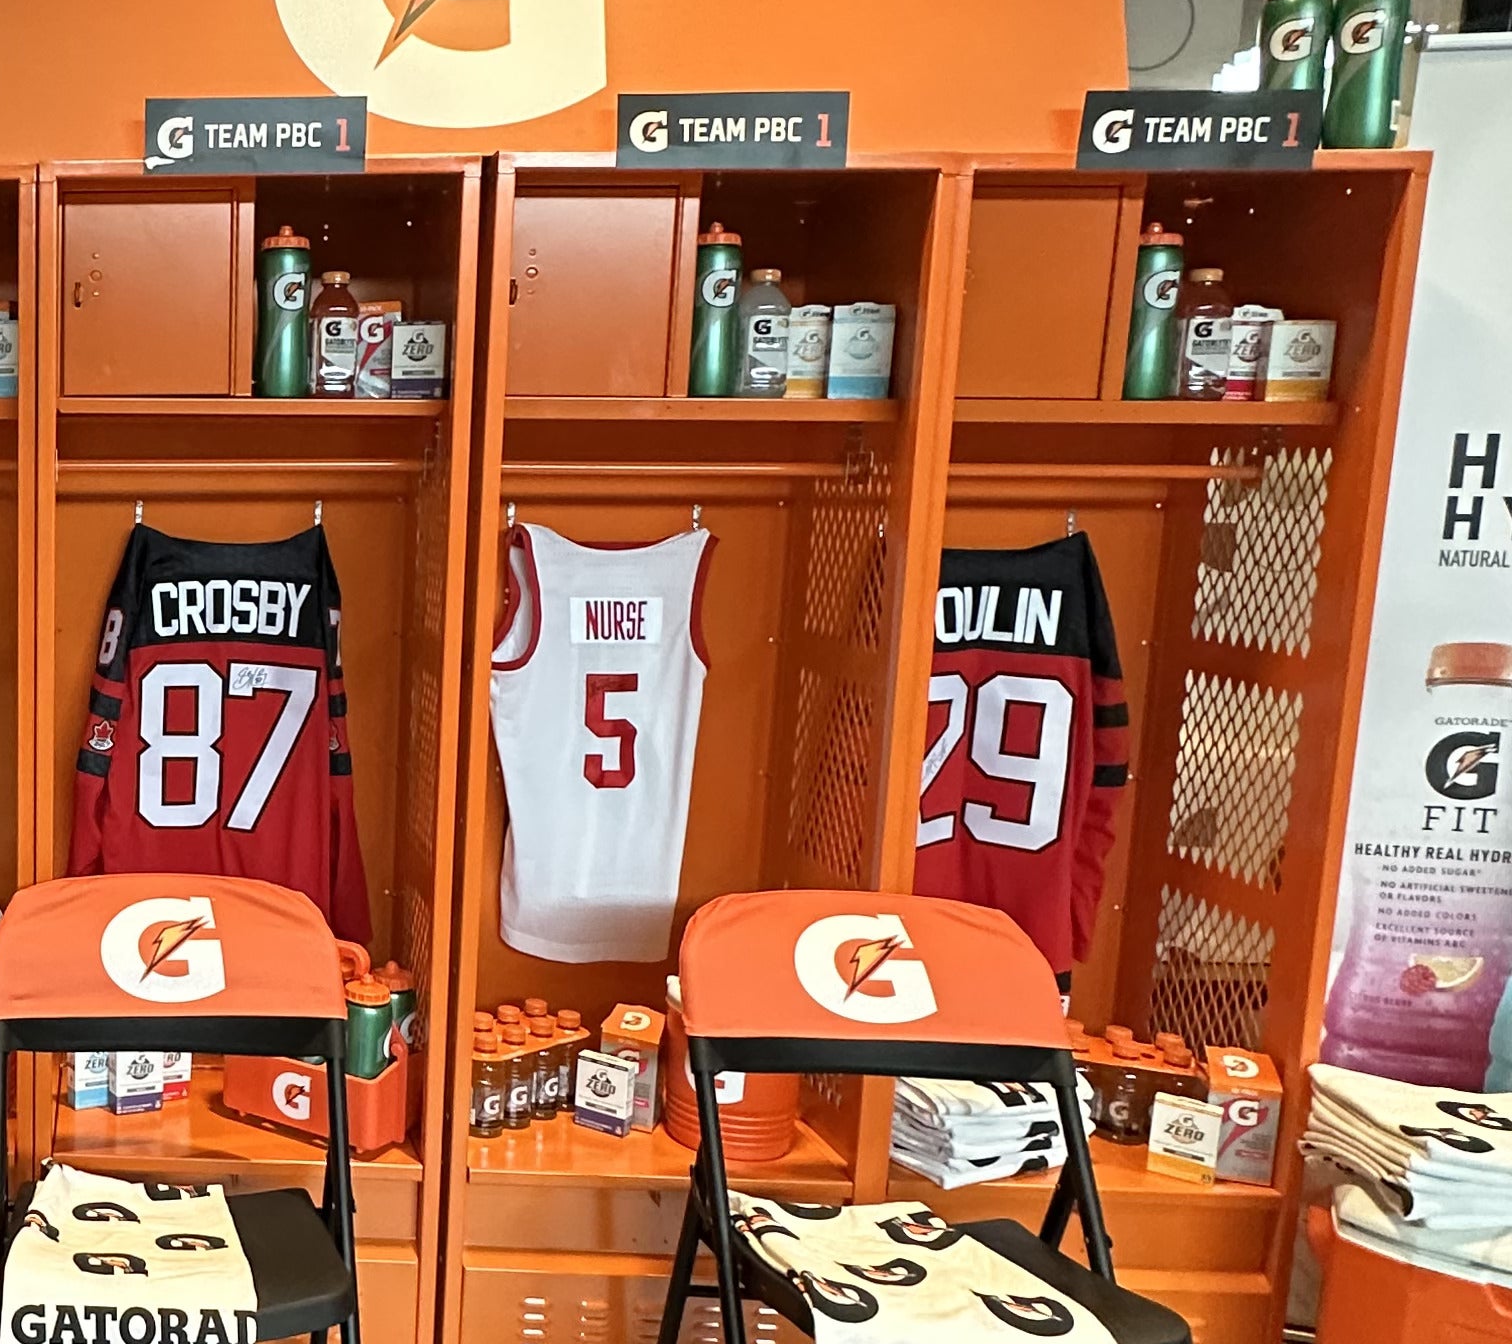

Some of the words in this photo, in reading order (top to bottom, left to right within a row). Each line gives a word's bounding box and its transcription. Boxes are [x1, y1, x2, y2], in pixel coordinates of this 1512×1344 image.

[1269, 17, 1314, 62] G
[1340, 9, 1385, 54] G
[157, 116, 193, 158] G
[205, 124, 268, 148] TEAM
[276, 122, 322, 148] PBC
[335, 118, 351, 151] 1
[629, 111, 668, 152] G
[679, 117, 745, 142] TEAM
[754, 116, 803, 142] PBC
[816, 113, 832, 147] 1
[1092, 108, 1134, 154] G
[1144, 117, 1212, 143] TEAM
[1220, 116, 1271, 143] PBC
[1282, 112, 1301, 147] 1
[273, 272, 305, 311] G
[702, 269, 737, 307] G
[1144, 270, 1180, 309] G
[325, 321, 342, 336] G
[360, 316, 384, 343] G
[754, 319, 772, 335] G
[1194, 321, 1213, 338] G
[402, 343, 434, 355] ZERO
[1283, 344, 1320, 356] ZERO
[1439, 549, 1510, 567] NATURAL
[152, 579, 311, 638] CROSBY
[585, 600, 647, 640] NURSE
[99, 609, 124, 665] 8
[138, 662, 318, 830] 87
[584, 673, 638, 788] 5
[916, 674, 1074, 851] 29
[1425, 731, 1501, 800] G
[1422, 805, 1497, 833] FIT
[1355, 843, 1420, 858] HEALTHY
[1425, 847, 1463, 860] REAL
[1380, 881, 1396, 889] NO
[1382, 864, 1398, 872] NO
[1402, 866, 1436, 874] ADDED
[1397, 893, 1442, 903] FLAVORS
[100, 896, 226, 1004] G
[794, 913, 938, 1024] G
[126, 1064, 154, 1076] ZERO
[586, 1077, 616, 1096] ZERO
[272, 1071, 311, 1120] G
[483, 1095, 500, 1115] G
[510, 1086, 528, 1106] G
[1229, 1100, 1260, 1127] G
[1164, 1124, 1204, 1142] ZERO
